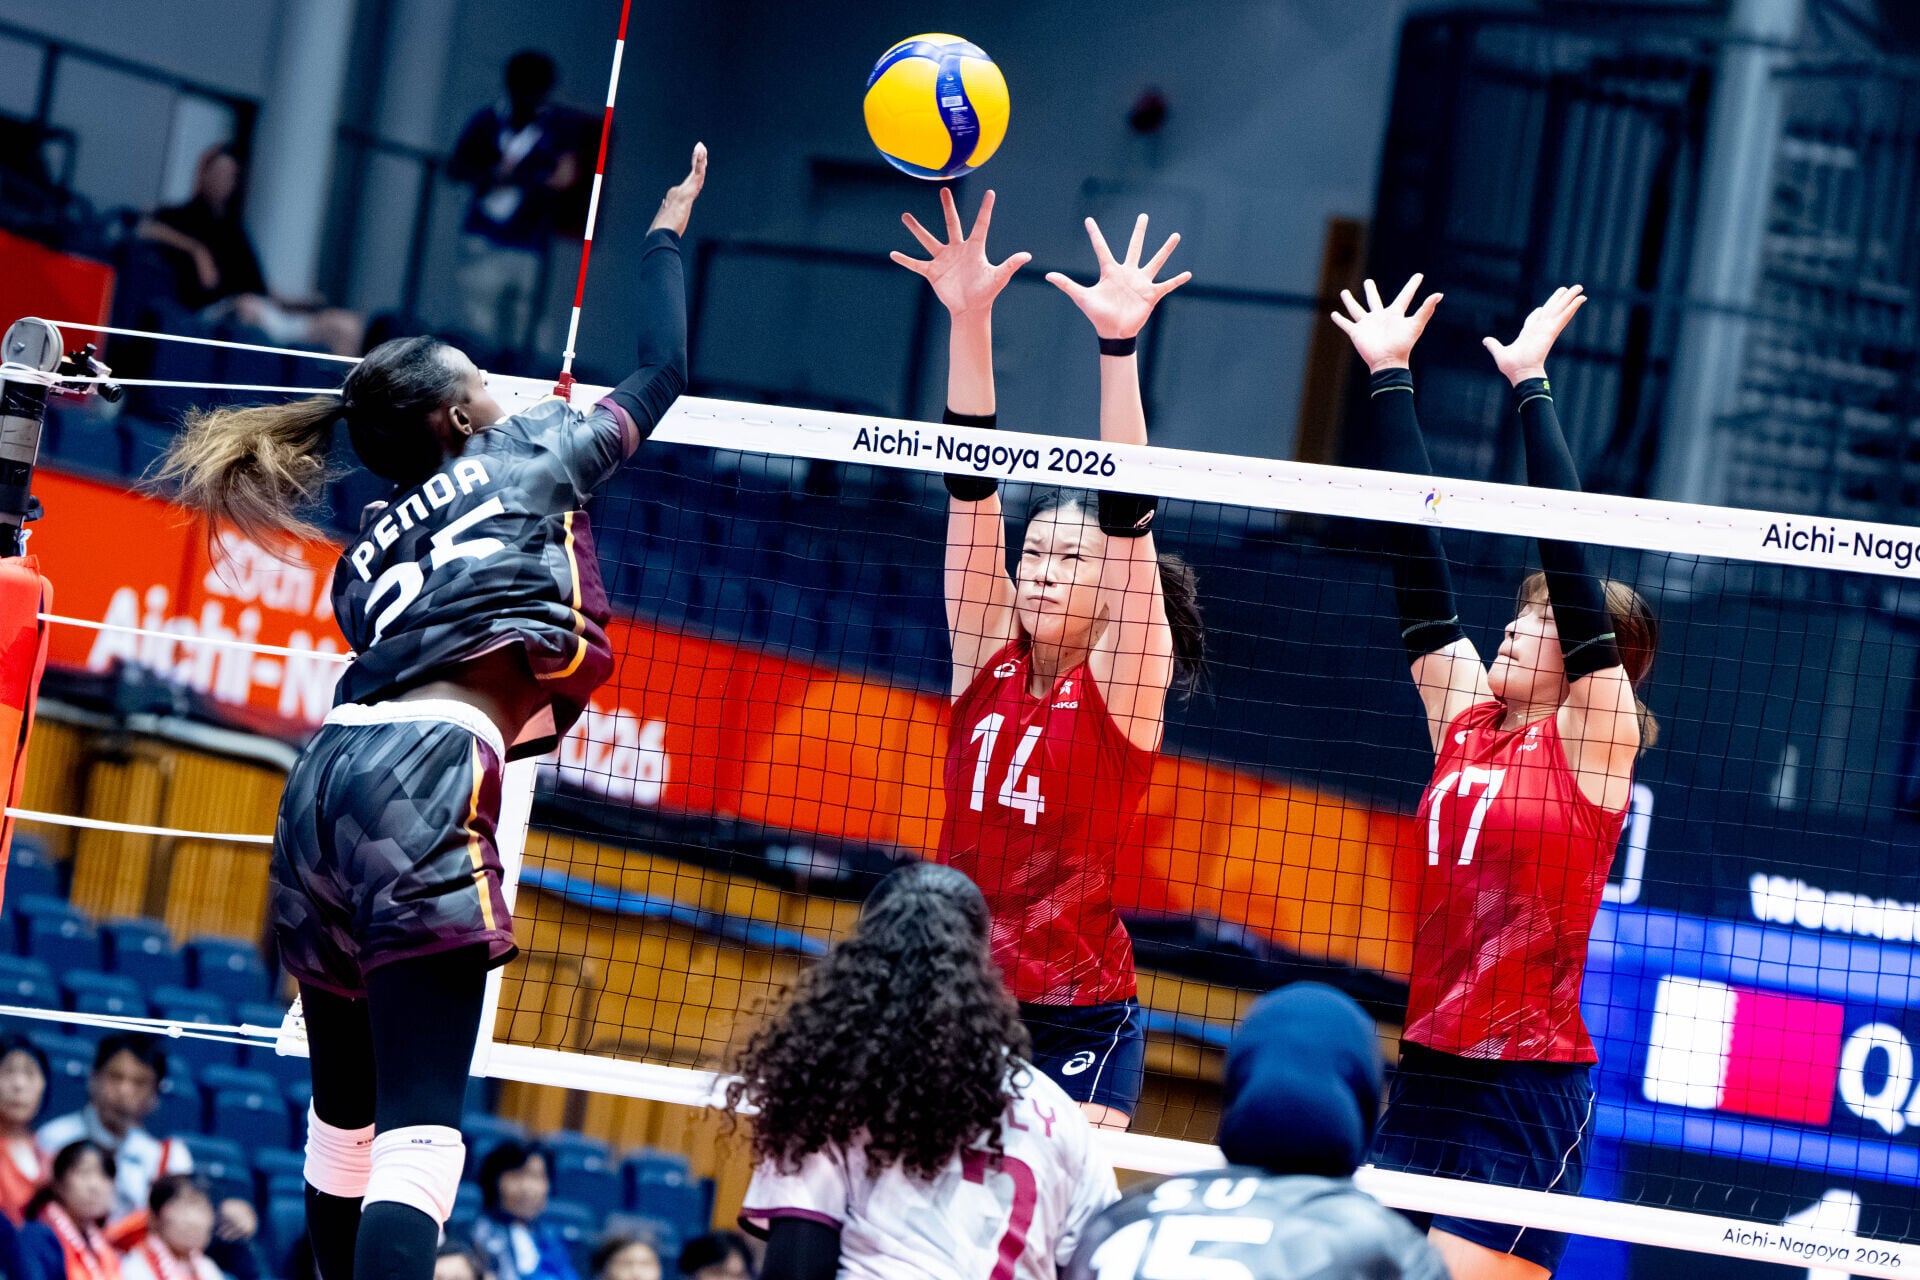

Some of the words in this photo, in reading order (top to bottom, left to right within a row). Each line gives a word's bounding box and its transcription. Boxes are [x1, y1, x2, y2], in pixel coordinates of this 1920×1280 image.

[853, 426, 1040, 474] Aichi-Nagoya
[1047, 447, 1117, 477] 2026
[351, 459, 490, 583] PENDA
[1762, 522, 1920, 569] Aichi-Nag
[86, 584, 346, 725] Aichi-N
[537, 698, 672, 805] 026
[969, 712, 1045, 826] 14
[1428, 766, 1507, 866] 17
[1004, 1097, 1057, 1139] LY
[1838, 1022, 1920, 1136] Q
[1722, 1226, 1850, 1263] Aichi-Nagoya
[1854, 1247, 1902, 1268] 2026
